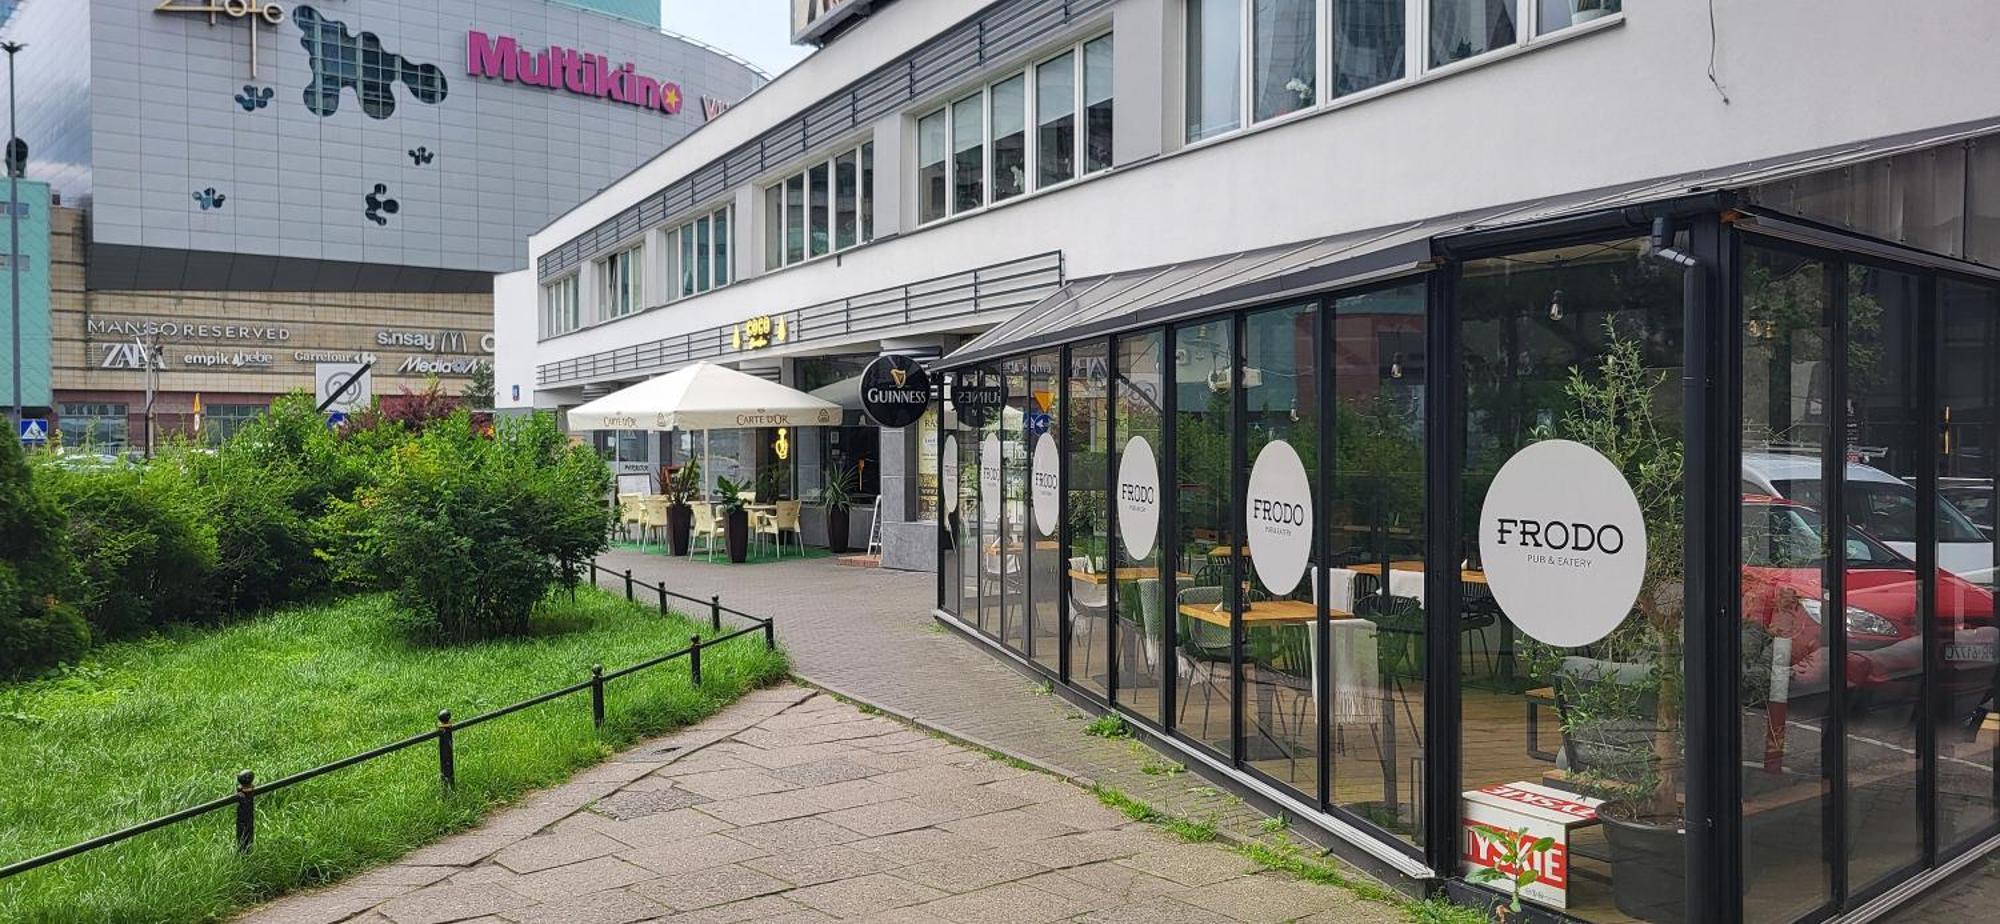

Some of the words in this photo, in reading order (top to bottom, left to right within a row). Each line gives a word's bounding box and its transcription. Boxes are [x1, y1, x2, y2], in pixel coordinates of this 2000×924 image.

[467, 30, 683, 115] Multikino
[87, 319, 177, 337] MANGO
[183, 323, 290, 340] RESERVED
[746, 316, 770, 336] COCO
[377, 329, 435, 349] sinsay
[184, 352, 229, 366] empik
[867, 387, 926, 404] GUINNESS
[736, 414, 765, 426] CARTE
[1035, 472, 1058, 490] FRODO
[1122, 483, 1154, 505] FRODO
[1253, 499, 1305, 527] FRODO
[1497, 518, 1624, 555] FRODO
[1527, 554, 1546, 564] PUB
[1548, 555, 1555, 565] &
[1558, 556, 1592, 568] EATERY
